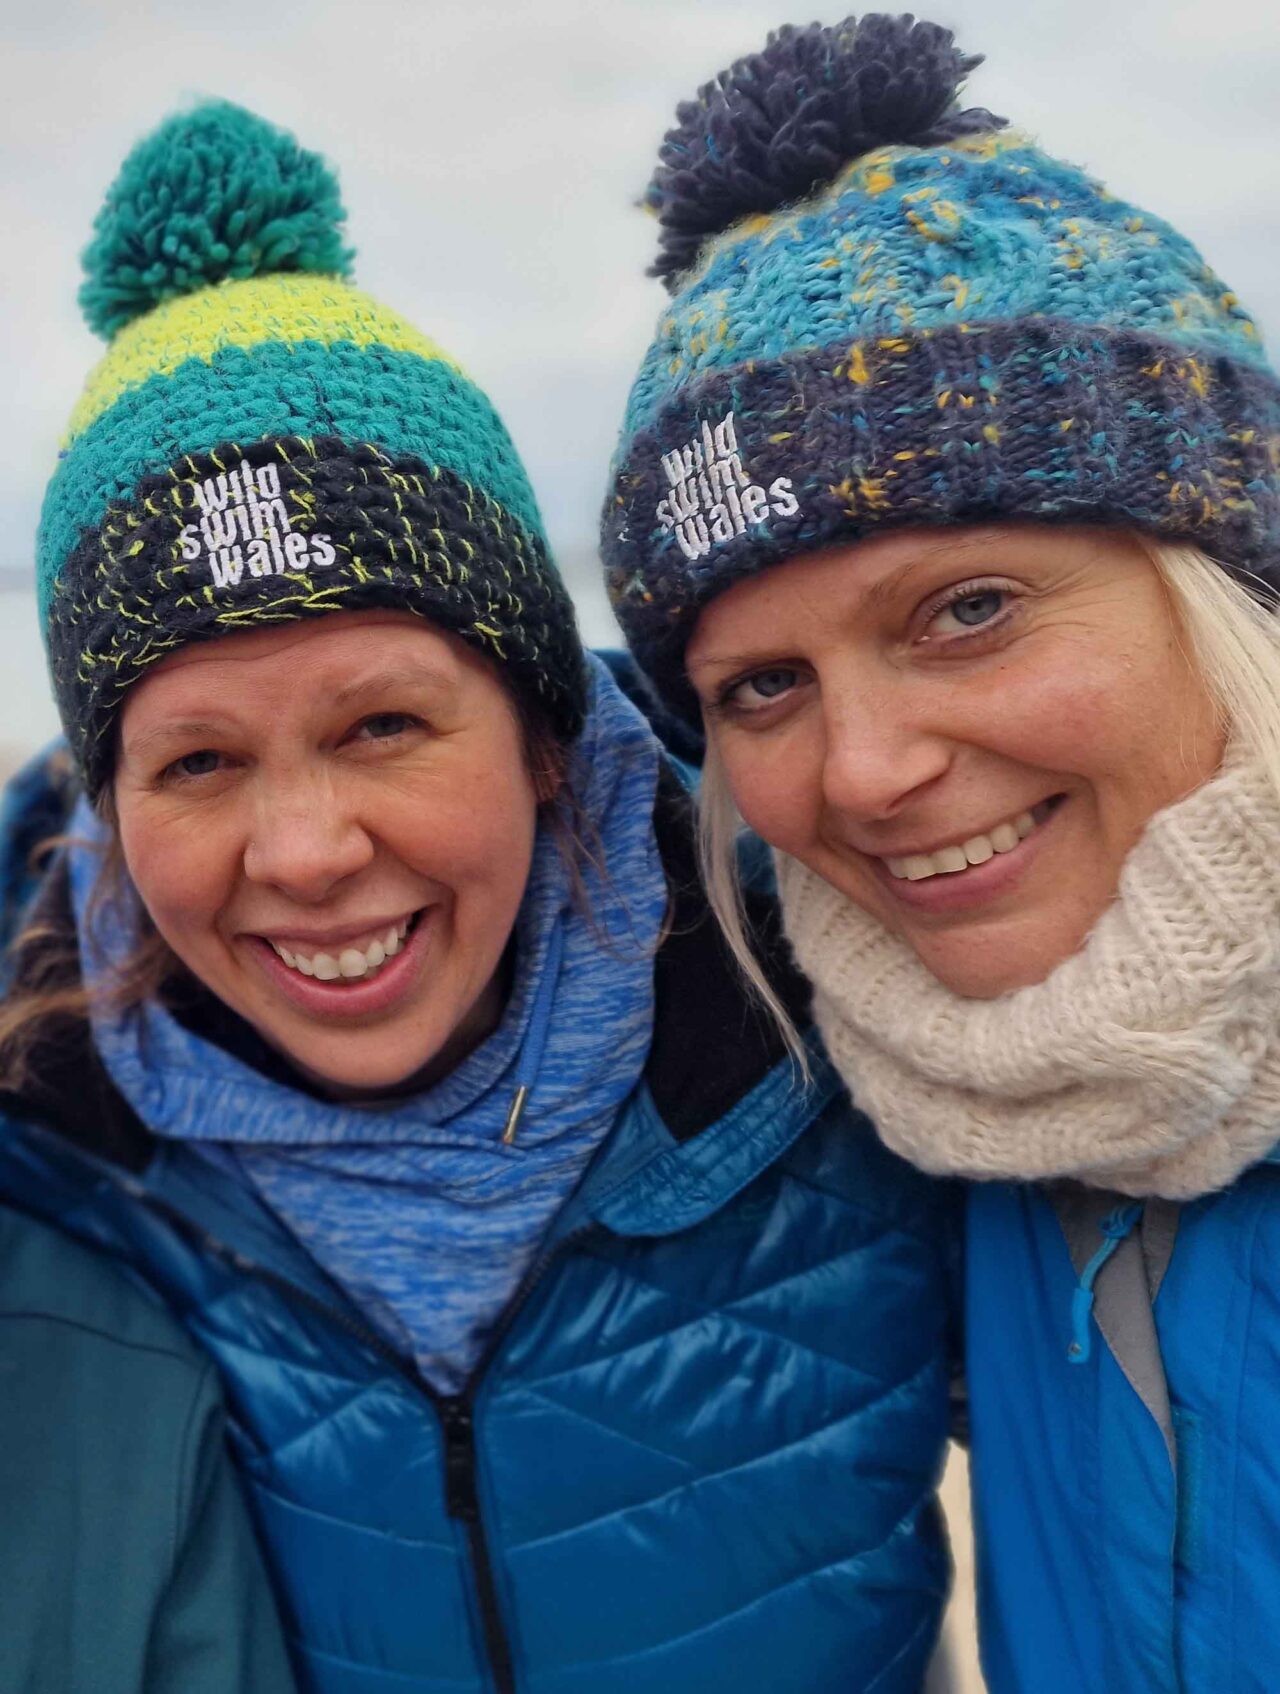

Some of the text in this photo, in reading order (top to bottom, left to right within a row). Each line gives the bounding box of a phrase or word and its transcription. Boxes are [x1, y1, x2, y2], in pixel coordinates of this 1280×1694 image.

[661, 411, 738, 487] wild
[193, 459, 281, 516] wild
[656, 453, 751, 534] swim
[674, 477, 800, 560] wales
[180, 499, 291, 560] swim
[208, 527, 336, 588] wales
